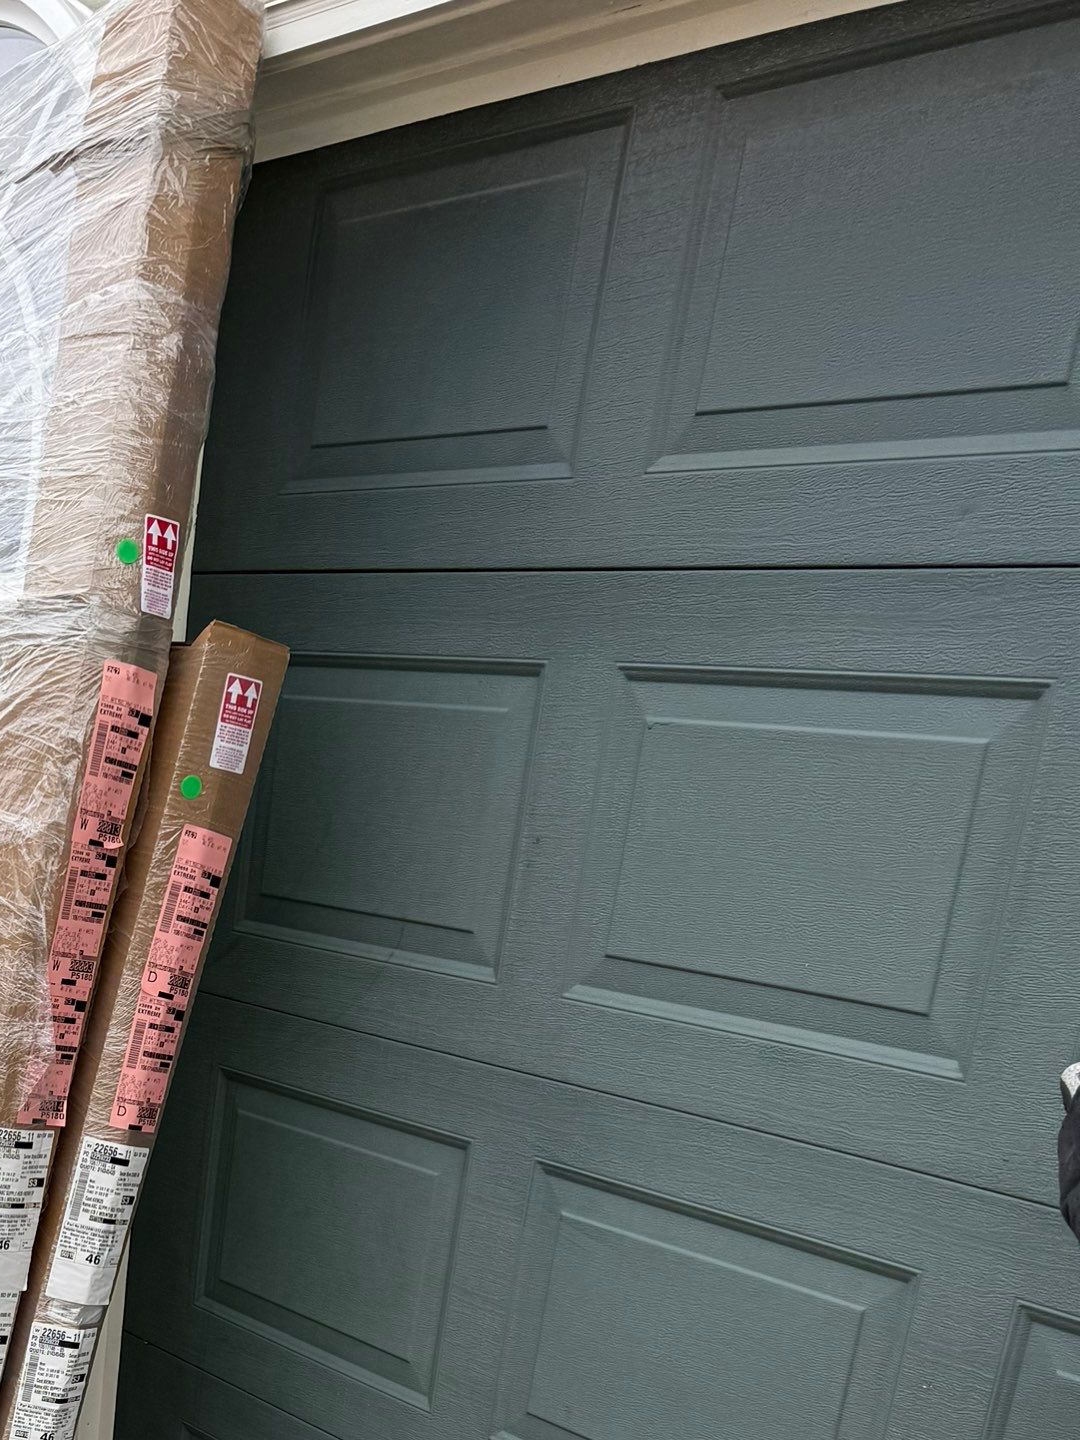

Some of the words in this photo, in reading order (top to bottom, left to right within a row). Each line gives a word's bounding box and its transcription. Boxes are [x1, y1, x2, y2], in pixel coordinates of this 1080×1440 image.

[100, 708, 122, 719] EXTREME
[80, 818, 89, 830] W
[71, 855, 91, 864] EXTREME
[174, 870, 196, 881] EXTREME
[52, 960, 61, 971] W
[147, 971, 158, 982] D
[138, 1009, 161, 1018] EXTREME
[23, 1101, 30, 1111] W
[117, 1105, 127, 1116] D
[94, 1143, 131, 1159] 22656-11
[86, 1254, 101, 1265] 46
[42, 1328, 80, 1341] 22656-11
